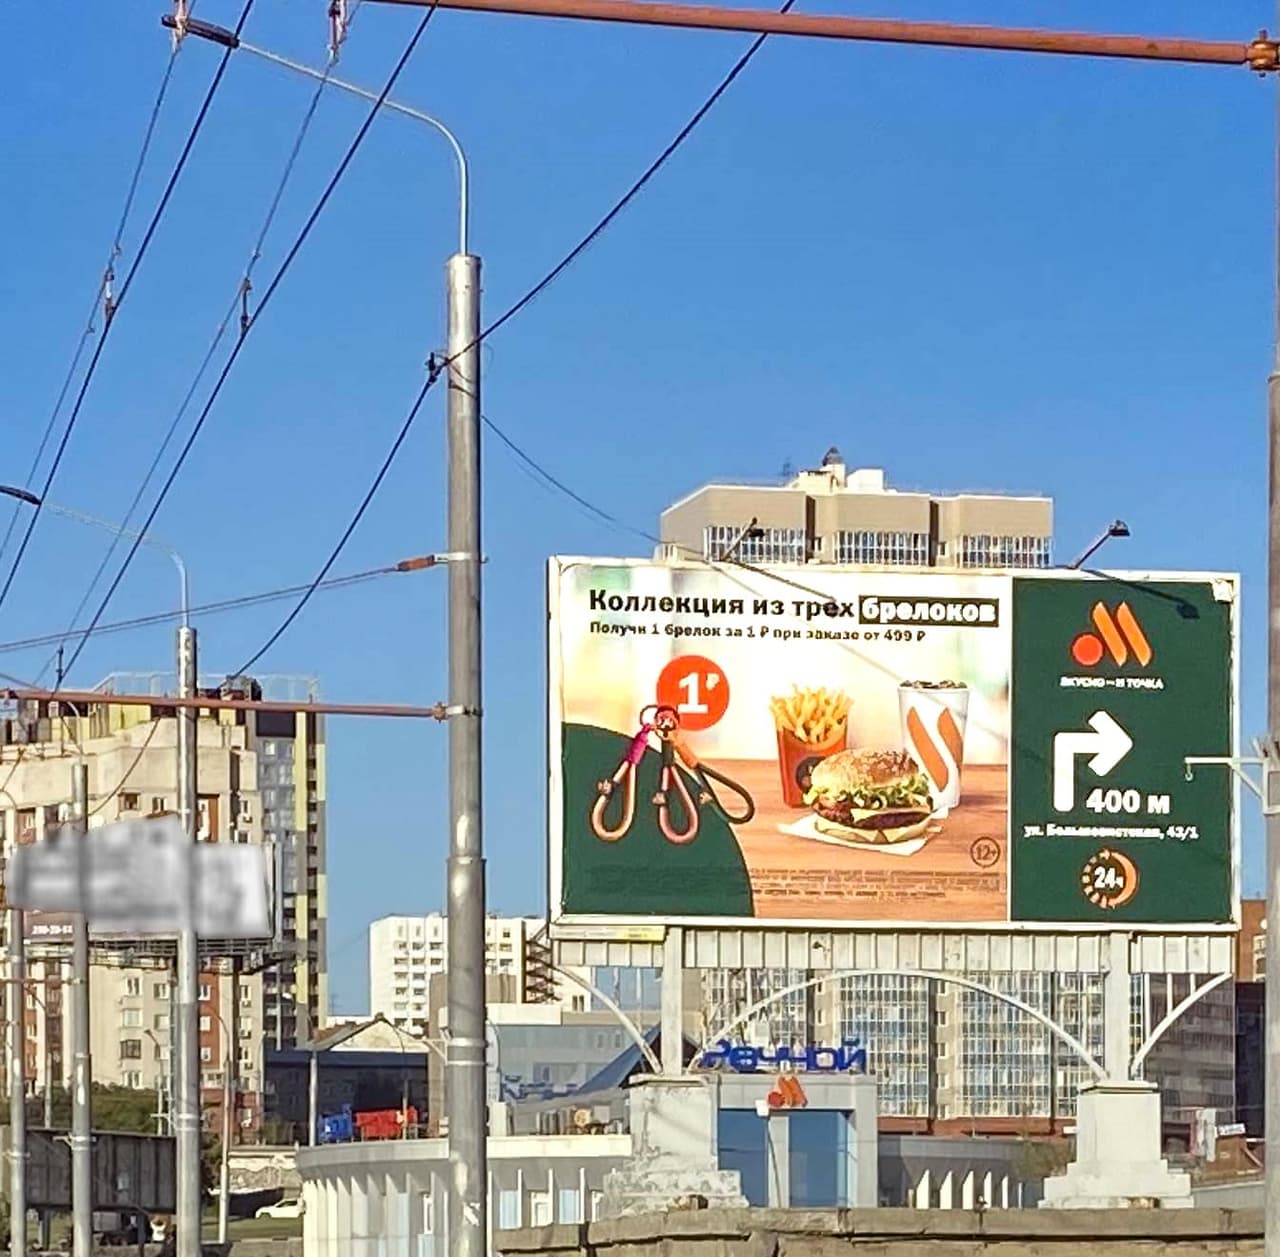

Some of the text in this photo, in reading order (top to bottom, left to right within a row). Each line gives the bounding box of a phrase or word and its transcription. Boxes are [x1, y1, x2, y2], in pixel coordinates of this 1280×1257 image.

[589, 589, 997, 624] Коллекция из трех брелоков
[590, 621, 647, 637] Получи
[652, 623, 660, 635] 1
[664, 623, 721, 639] брелок
[746, 626, 756, 638] 1
[773, 629, 802, 641] при
[863, 631, 880, 641] от
[1086, 788, 1141, 814] 400
[974, 845, 997, 861] 12+
